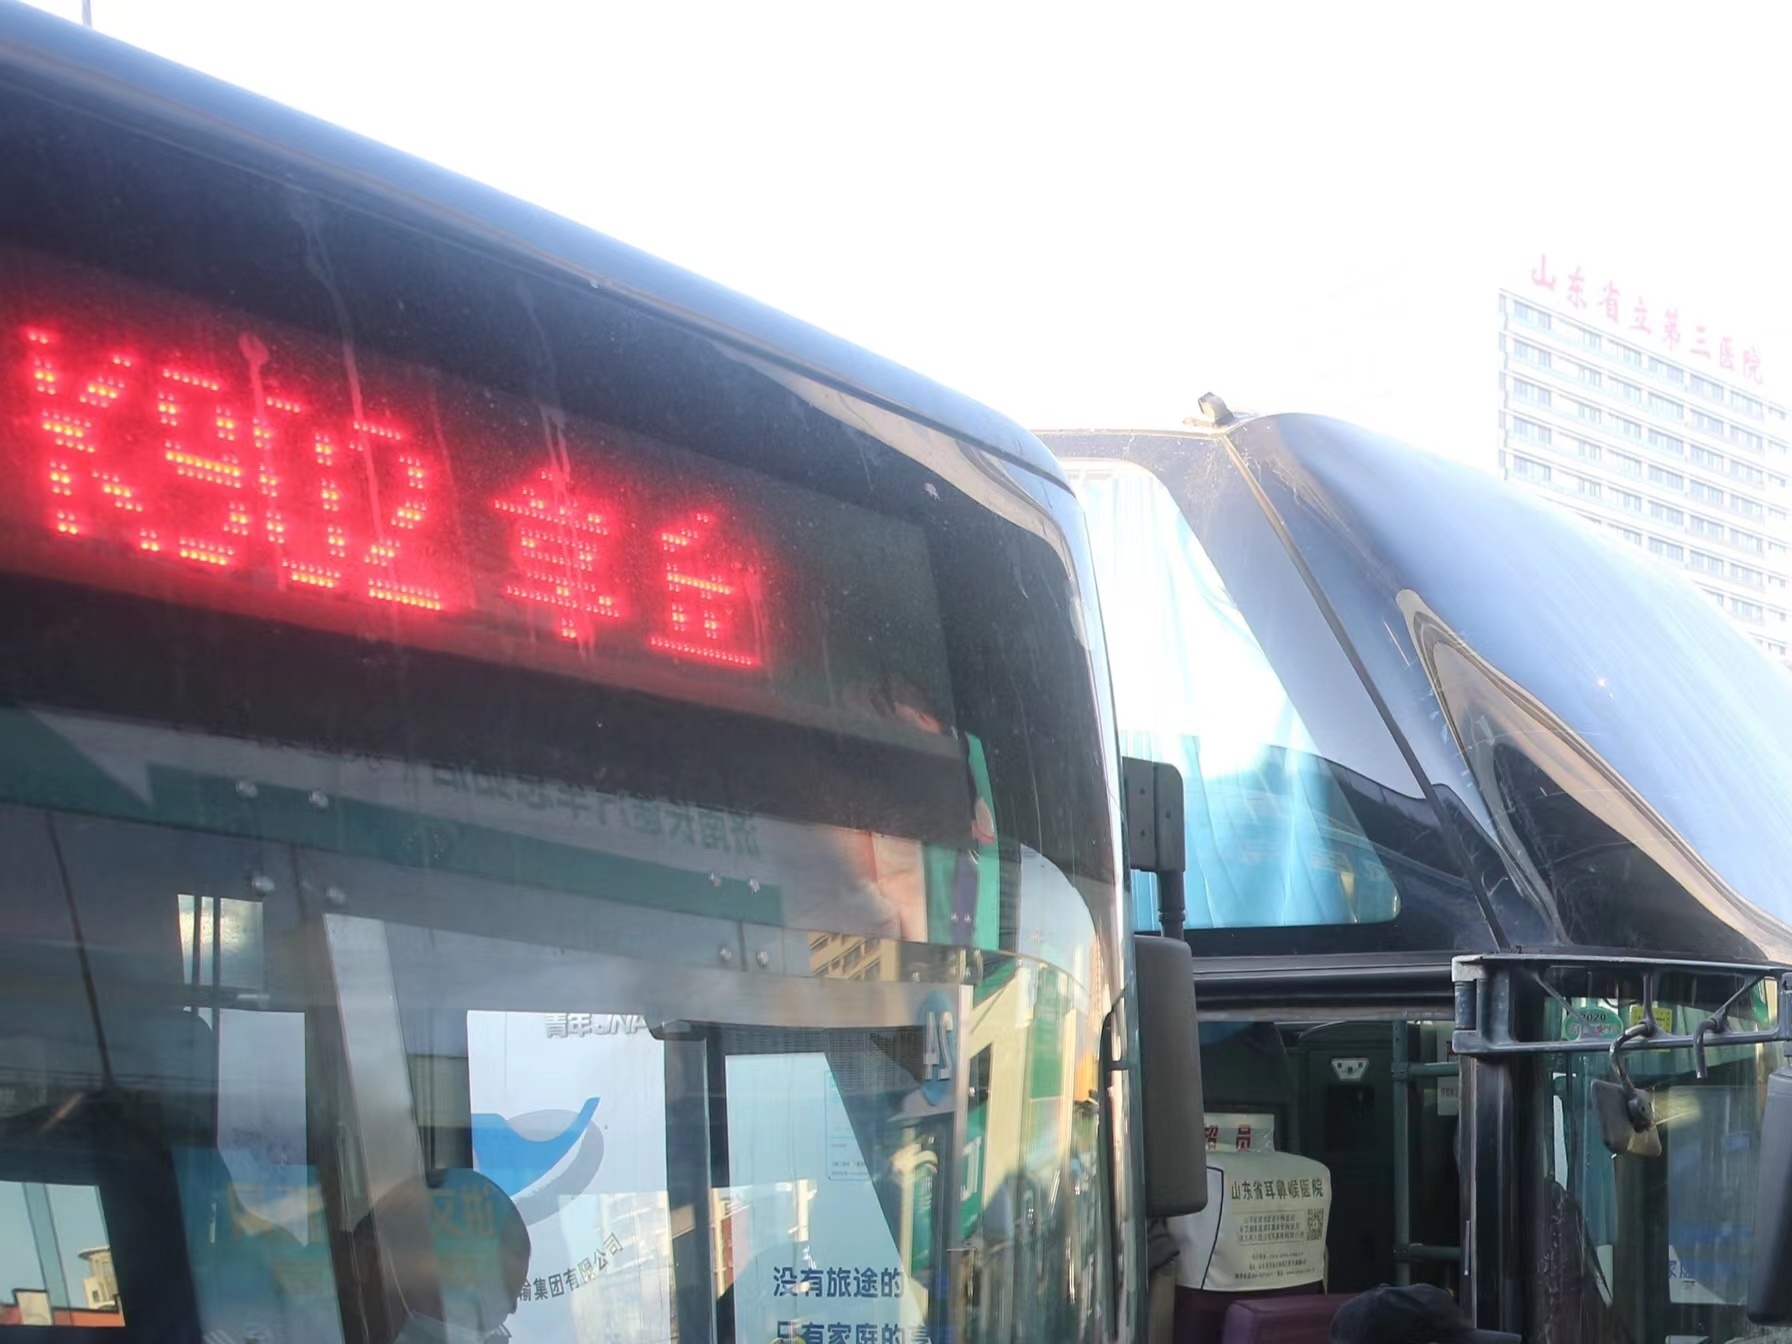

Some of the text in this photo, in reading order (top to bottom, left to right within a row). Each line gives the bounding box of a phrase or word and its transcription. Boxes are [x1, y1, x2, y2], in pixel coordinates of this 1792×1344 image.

[1531, 254, 1764, 385] 山东省立第三医院
[26, 329, 444, 612] K902
[772, 1265, 905, 1298] 没有旅途的
